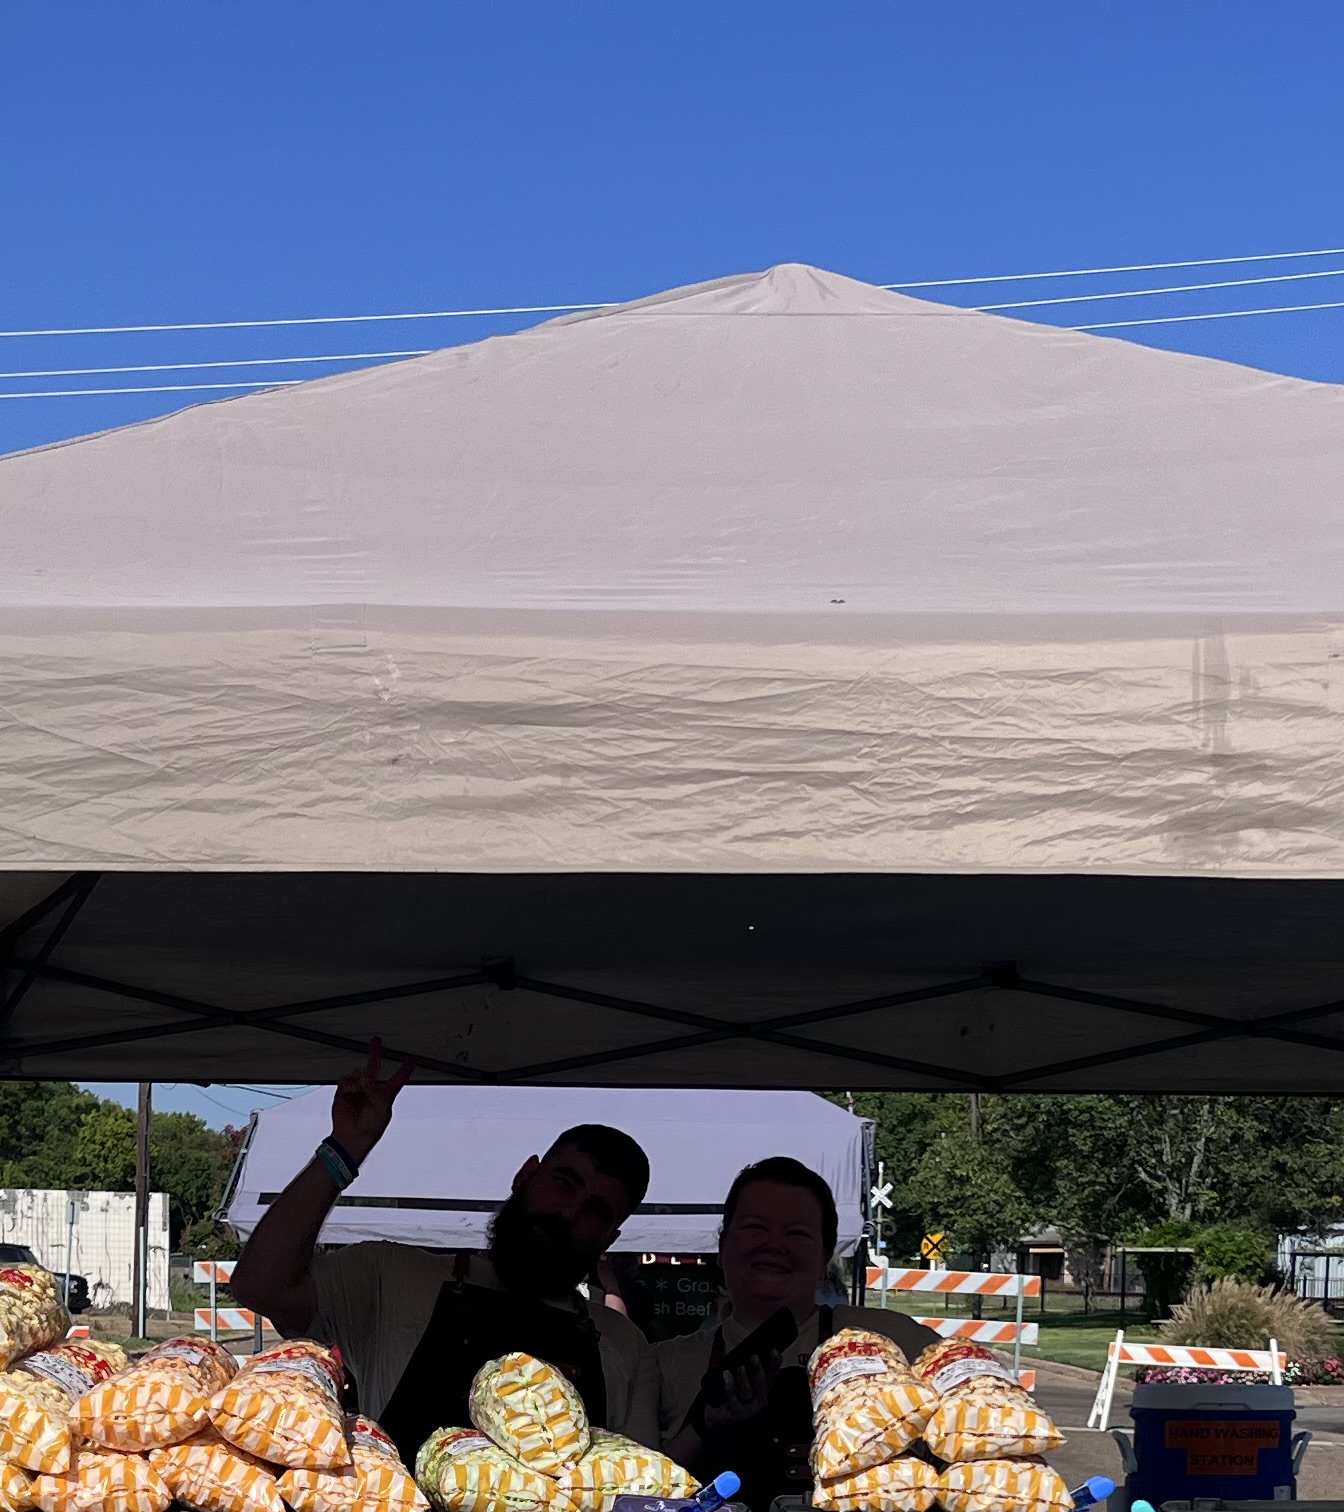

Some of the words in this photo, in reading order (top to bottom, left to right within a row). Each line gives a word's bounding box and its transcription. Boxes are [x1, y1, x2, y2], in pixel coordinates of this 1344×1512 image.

[675, 1301, 713, 1317] Beef
[1168, 1427, 1211, 1439] HAND
[1214, 1427, 1280, 1439] WASHING
[1189, 1454, 1255, 1467] STATION
